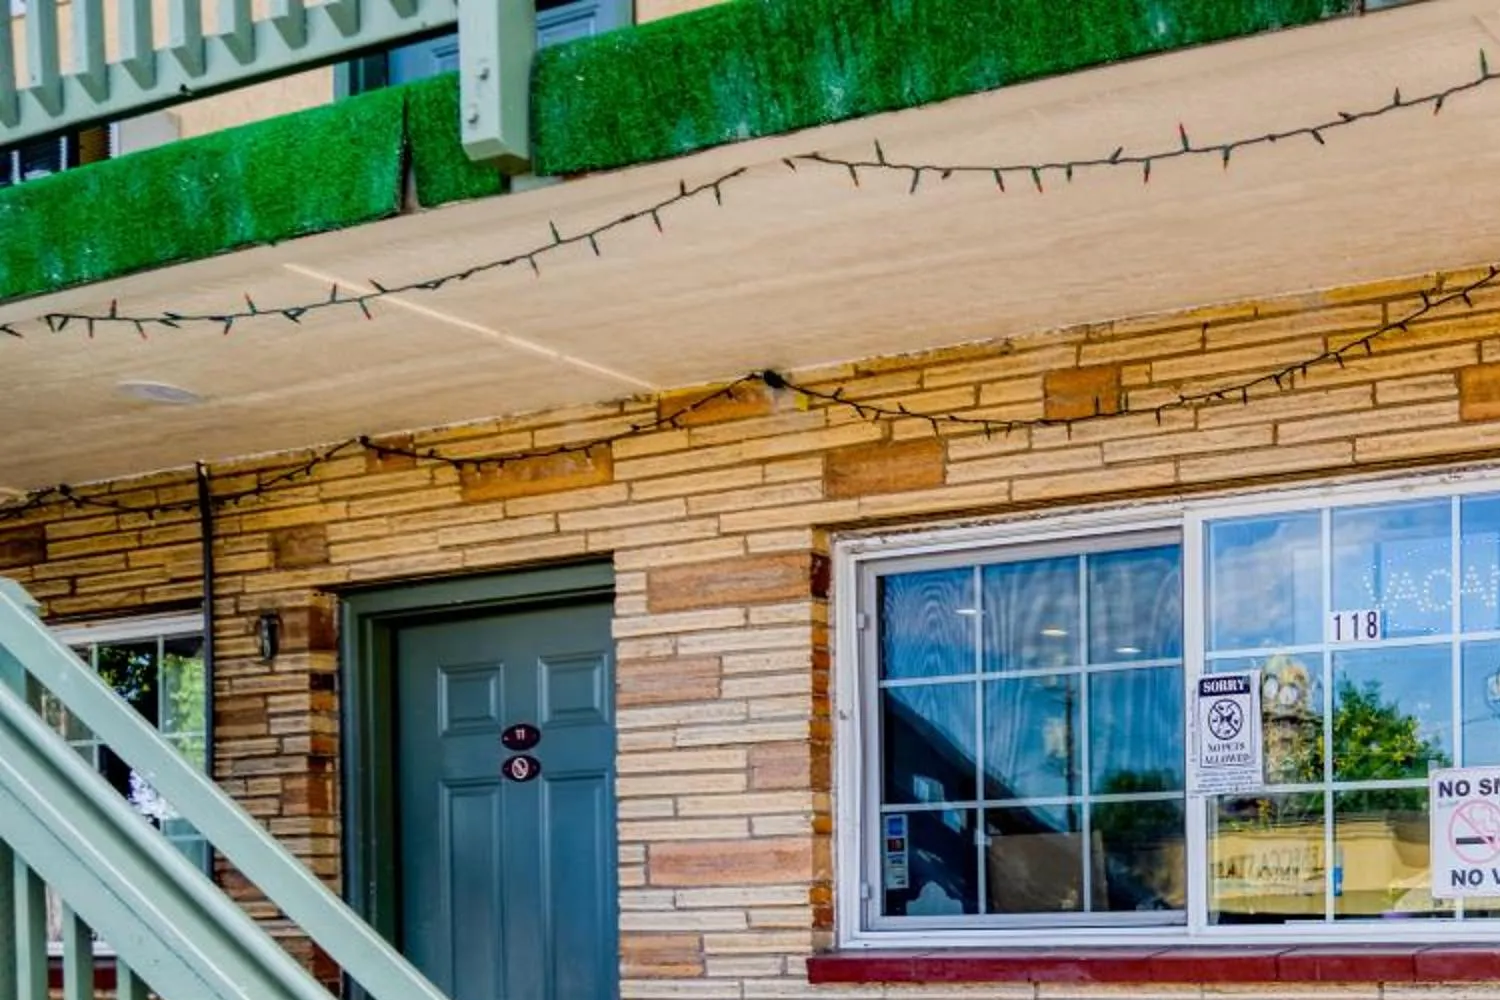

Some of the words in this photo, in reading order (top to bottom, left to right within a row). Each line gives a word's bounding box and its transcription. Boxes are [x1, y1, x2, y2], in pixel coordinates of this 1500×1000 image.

[1333, 610, 1377, 641] 118
[1203, 679, 1244, 693] SORRY
[1438, 780, 1471, 798] NO
[1451, 869, 1484, 887] NO
